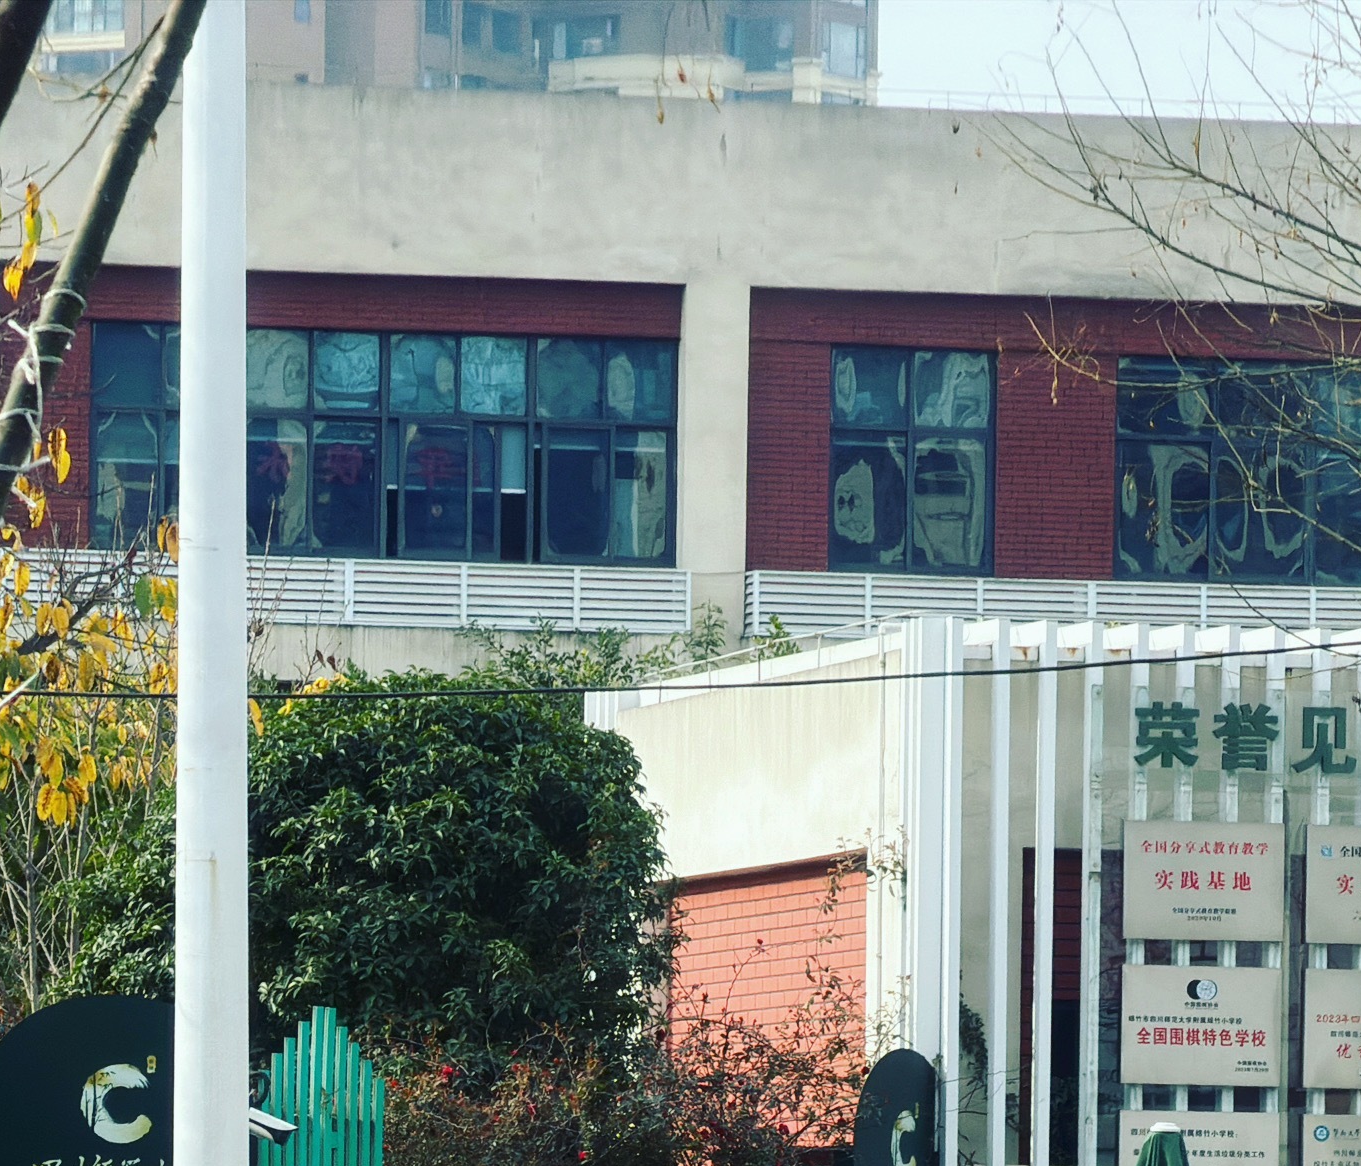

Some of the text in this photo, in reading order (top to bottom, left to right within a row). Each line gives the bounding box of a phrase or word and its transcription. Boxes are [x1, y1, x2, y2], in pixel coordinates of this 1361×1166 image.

[1140, 839, 1269, 856] 全国分享式教育教学
[1154, 869, 1252, 891] 实践基地
[1136, 1026, 1267, 1048] 全国围棋特色学校
